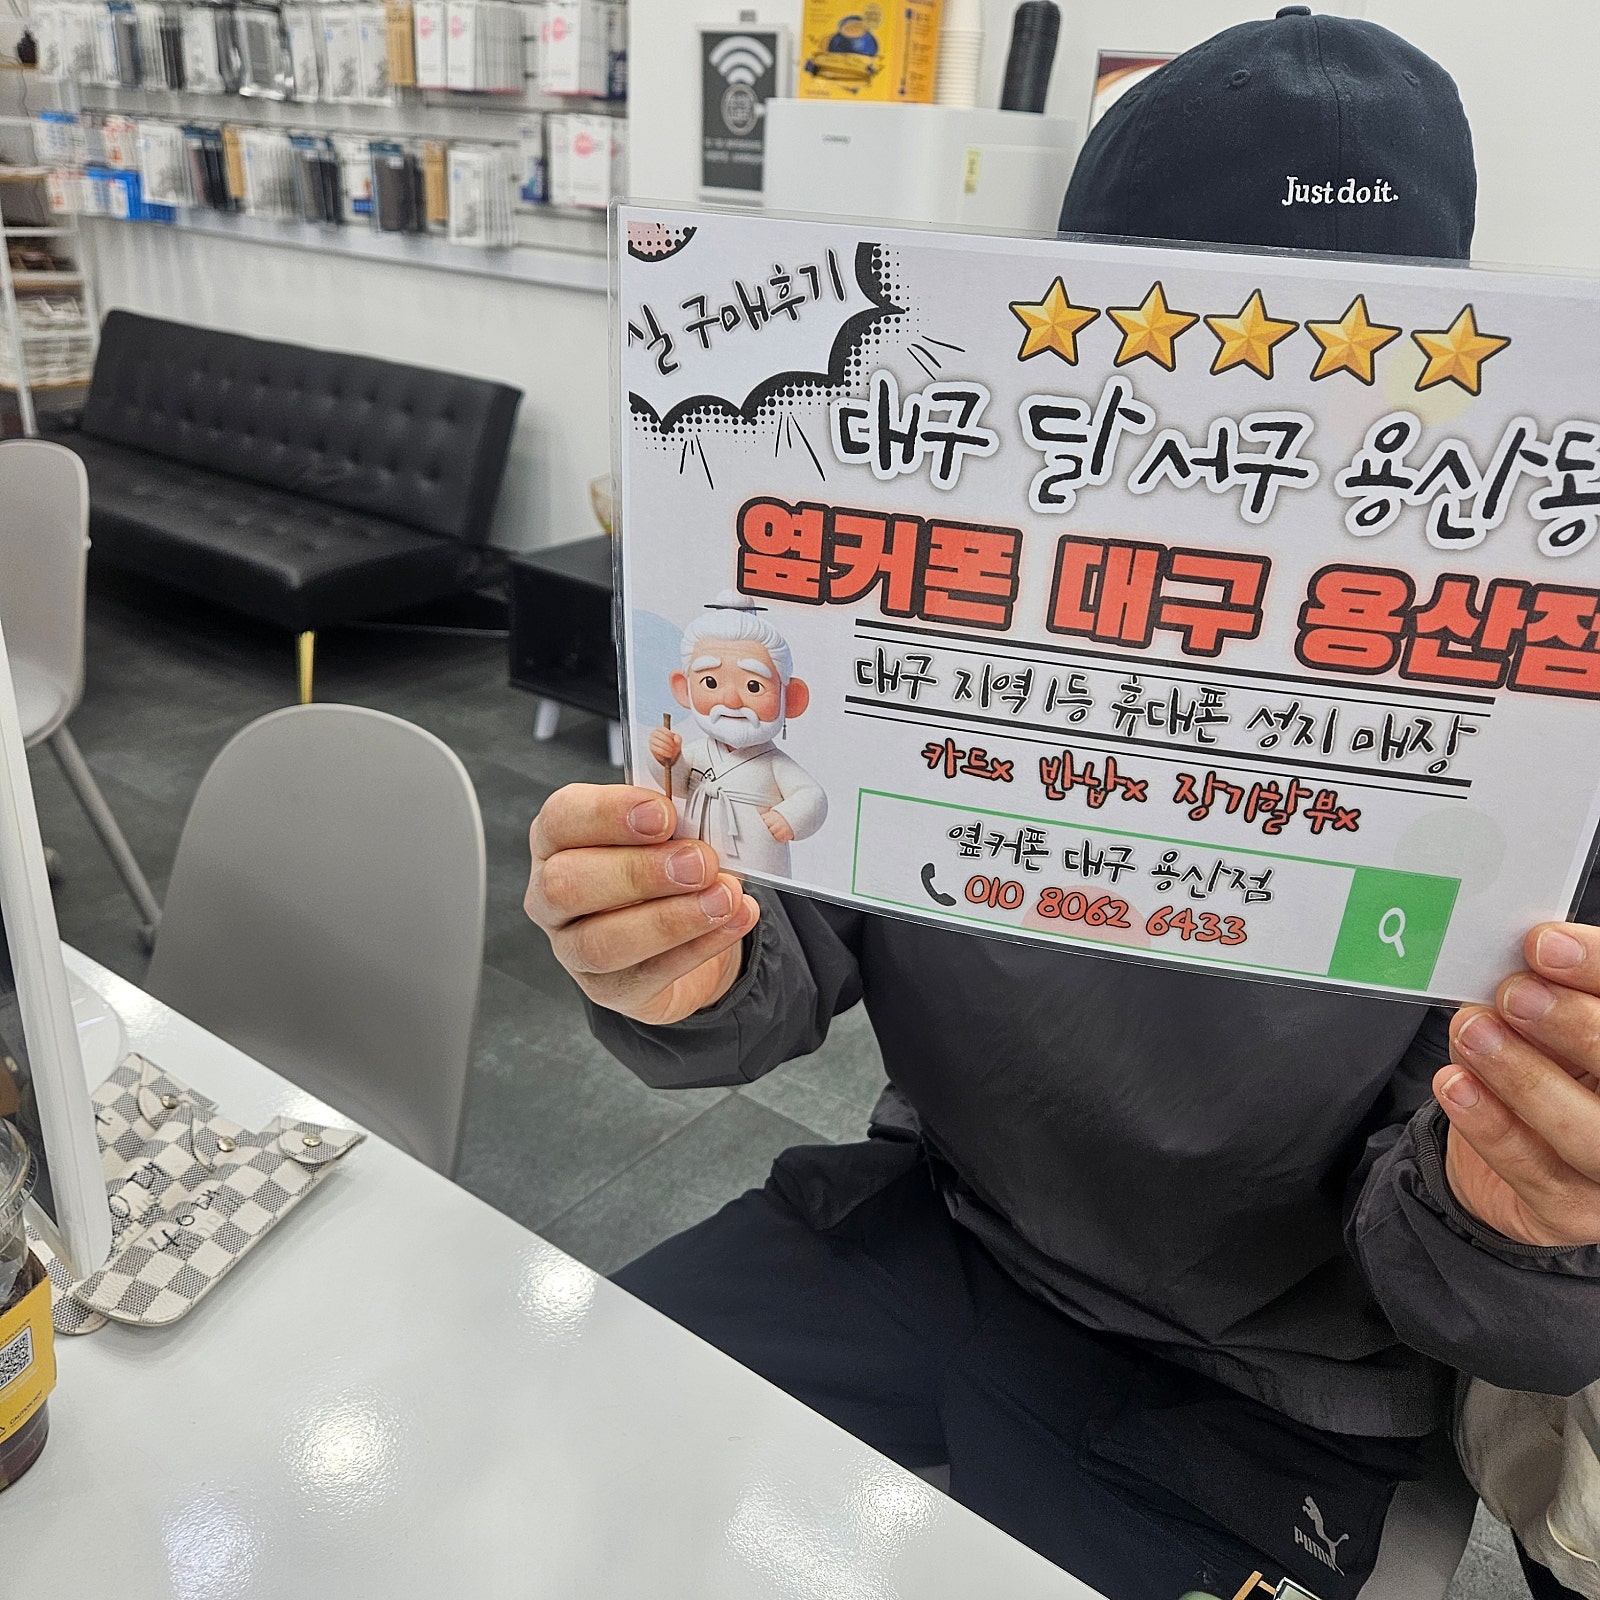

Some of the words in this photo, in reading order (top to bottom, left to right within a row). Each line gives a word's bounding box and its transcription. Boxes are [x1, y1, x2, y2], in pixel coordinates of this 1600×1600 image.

[1281, 175, 1335, 206] Just
[1337, 177, 1371, 204] do
[1373, 178, 1399, 203] it.
[627, 303, 679, 376] 실
[681, 248, 845, 349] 구매후기
[836, 376, 992, 482] 대구
[1026, 383, 1311, 514] 달서구
[1343, 418, 1600, 549] 용산동
[736, 496, 1024, 632] 옆커폰
[1045, 534, 1272, 657] 대구
[1294, 563, 1600, 699] 용산점
[855, 647, 938, 700] 대구
[954, 663, 1034, 714] 지역
[1045, 673, 1094, 723] 1등
[1110, 674, 1231, 744] 휴대폰
[1246, 700, 1339, 755] 성지
[1350, 711, 1479, 775] 매장
[948, 821, 1050, 872] 옆커폰
[1064, 839, 1137, 883] 대구
[1150, 849, 1274, 904] 용산점
[965, 875, 1024, 909] 010
[1037, 886, 1132, 929] 8062
[1146, 905, 1248, 945] 6433
[1294, 1525, 1336, 1572] PUMA
